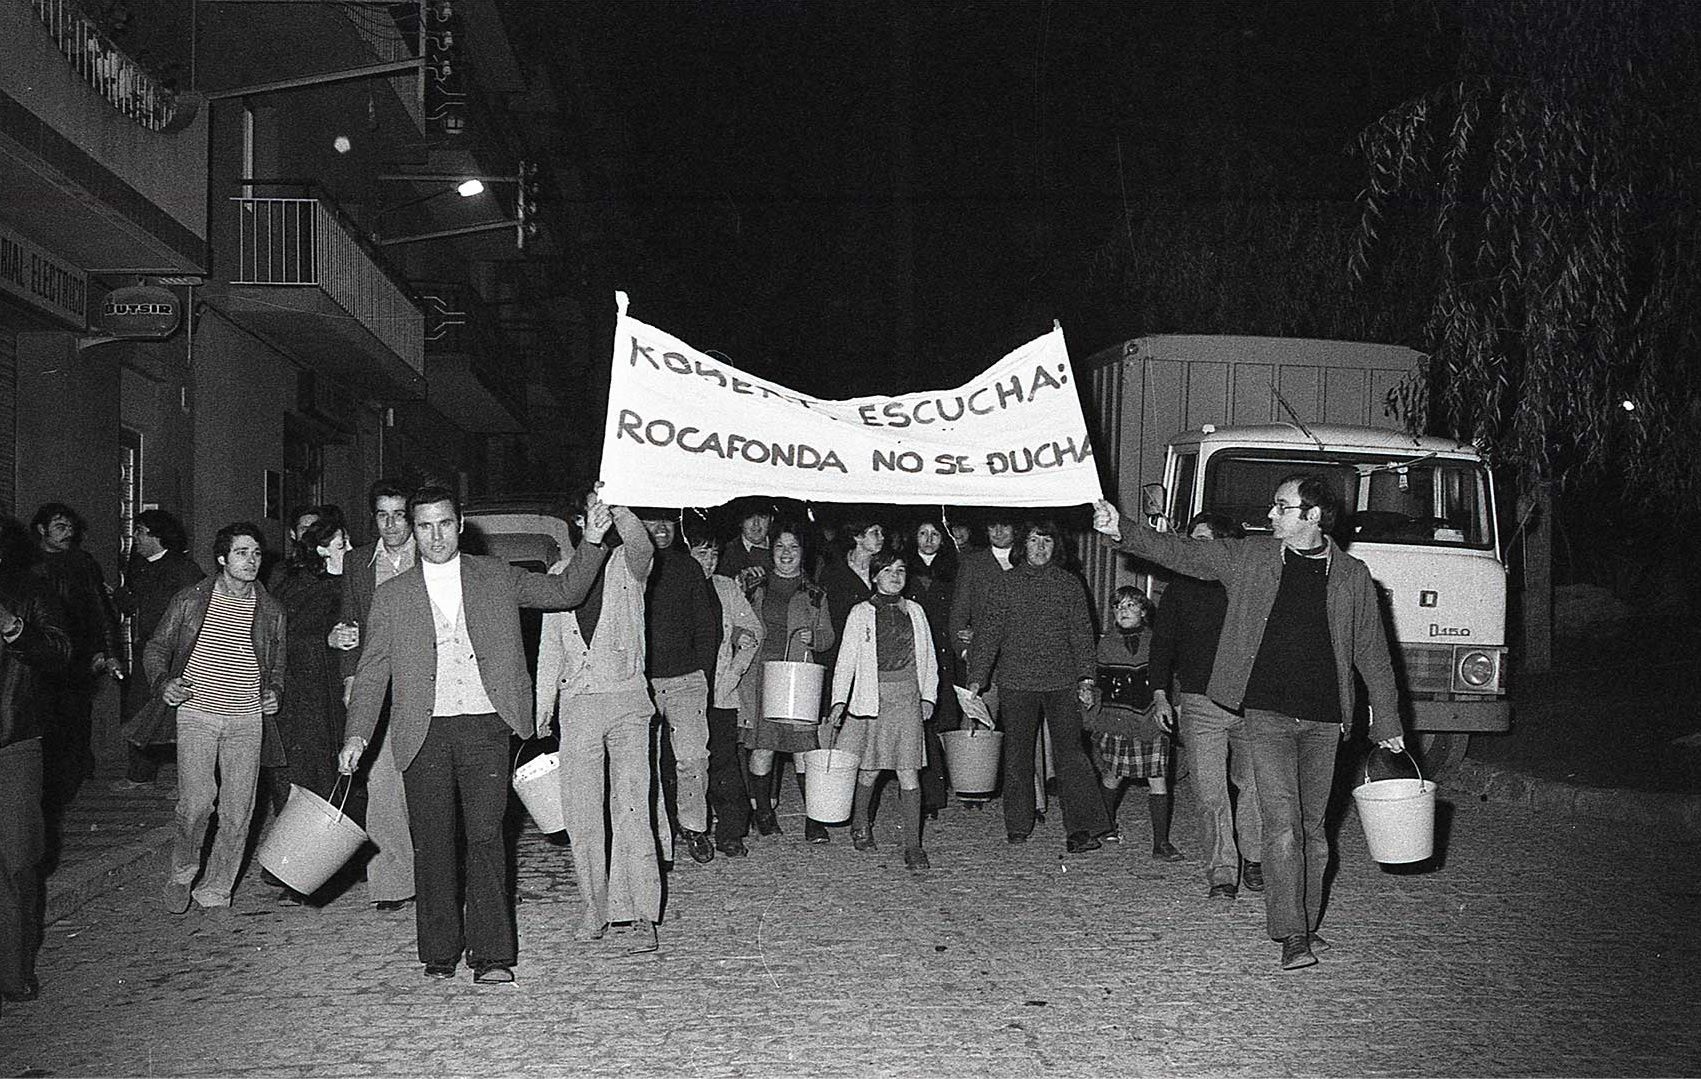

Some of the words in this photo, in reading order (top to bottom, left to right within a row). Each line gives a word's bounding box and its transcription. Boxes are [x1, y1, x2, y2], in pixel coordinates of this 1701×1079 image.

[858, 363, 1068, 428] ESCUCHA:
[616, 409, 848, 474] ROCAFONDA
[872, 450, 924, 473] NO
[934, 454, 975, 475] SE
